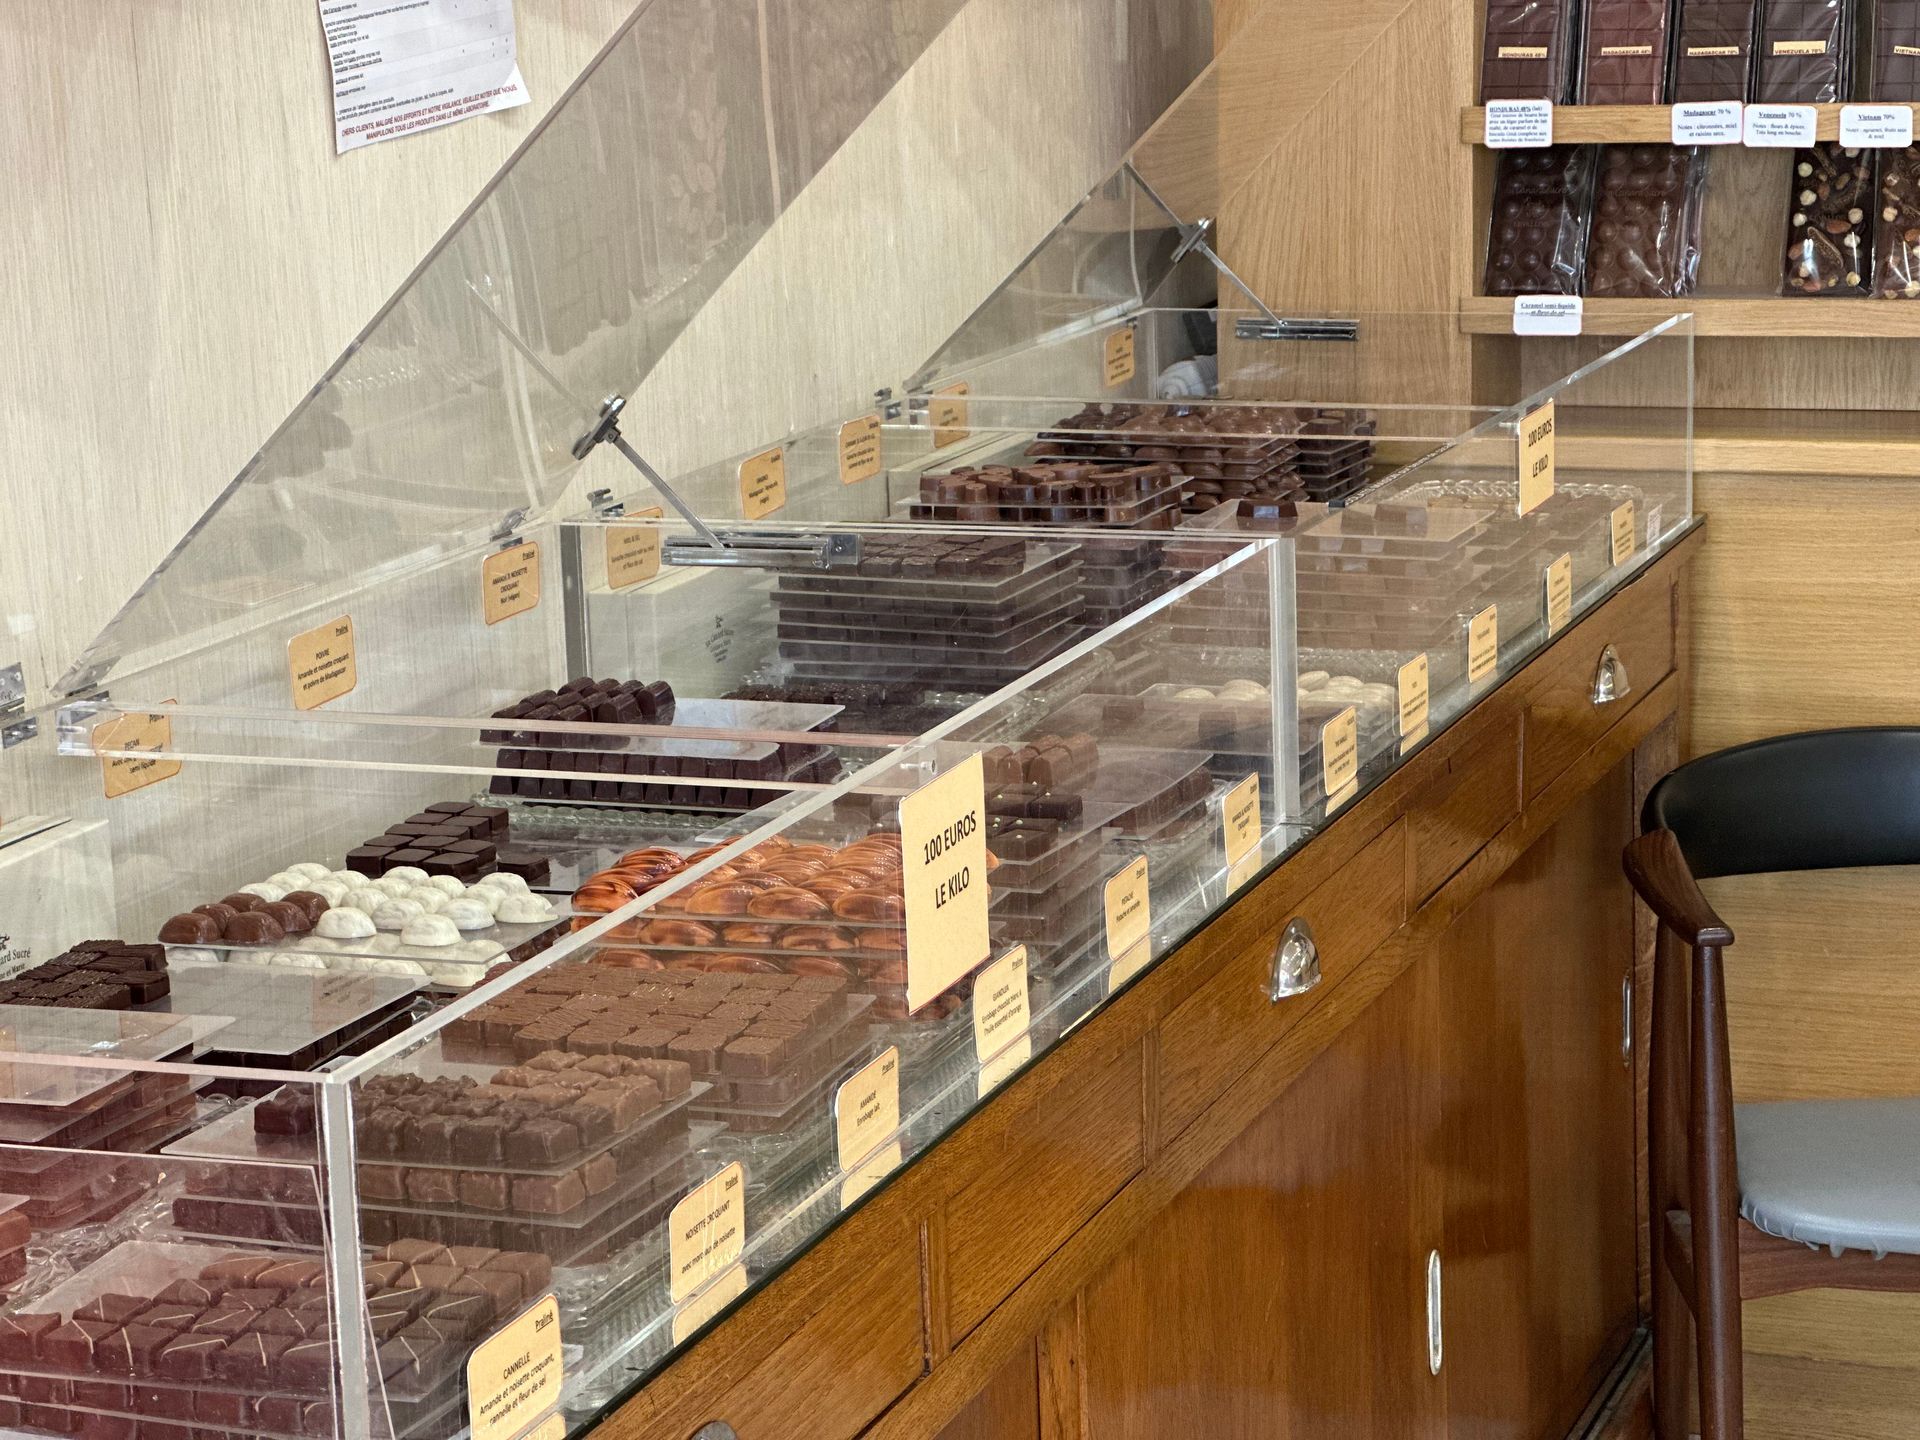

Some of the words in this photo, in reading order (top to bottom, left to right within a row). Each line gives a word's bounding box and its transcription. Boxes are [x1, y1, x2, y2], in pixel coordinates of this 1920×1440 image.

[341, 126, 355, 138] CHERS
[355, 121, 375, 134] CLIENTS,
[374, 116, 393, 130] MALGRÉ
[393, 115, 403, 125] NOS
[403, 110, 422, 123] EFFORTS
[428, 105, 442, 117] NOTRE
[462, 94, 480, 108] VEUILLEZ
[480, 91, 493, 104] NOTER
[493, 87, 502, 98] QUE
[502, 84, 518, 96] NOUS
[1858, 114, 1882, 122] Vietnam
[366, 126, 394, 140] MANIPULONS
[394, 122, 406, 134] TOUS
[406, 121, 415, 131] LES
[414, 116, 436, 130] PRODUITS
[436, 114, 447, 126] DANS
[452, 108, 464, 120] MÊME
[1520, 302, 1544, 310] Caramel
[1528, 428, 1537, 448] 100
[1537, 418, 1552, 441] EUROS
[1532, 461, 1538, 478] LE
[1538, 454, 1548, 474] KILO
[336, 624, 349, 637] Praliné
[298, 668, 314, 680] Amande
[318, 660, 333, 672] noisette
[333, 653, 350, 666] croquant
[316, 648, 330, 661] POIVRE
[308, 678, 320, 690] poivre
[320, 675, 324, 684] de
[324, 666, 346, 681] Madagascar
[924, 834, 942, 866] 100
[944, 810, 977, 852] EUROS
[935, 882, 946, 910] LE
[948, 865, 970, 901] KILO
[12, 947, 31, 960] Sucré
[12, 963, 25, 974] Marie
[982, 1007, 998, 1024] Enrobage
[998, 999, 1011, 1014] chocolat
[882, 1058, 894, 1076] Praliné
[860, 1090, 876, 1110] AMANDE
[856, 1108, 874, 1128] Enrobage
[724, 1173, 738, 1191] Praliné
[684, 1218, 706, 1241] NOISETTE
[682, 1263, 692, 1274] avec
[712, 1240, 718, 1250] de
[718, 1226, 736, 1245] noisette
[535, 1309, 554, 1333] Praliné
[503, 1352, 530, 1380] CANNELLE
[480, 1394, 502, 1416] Amande
[502, 1389, 509, 1398] et
[508, 1372, 530, 1393] noisette
[530, 1354, 555, 1378] croquant,
[490, 1404, 512, 1425] cannelle
[512, 1398, 518, 1409] et
[518, 1390, 531, 1403] fleur
[530, 1382, 538, 1394] de
[538, 1374, 546, 1389] sel
